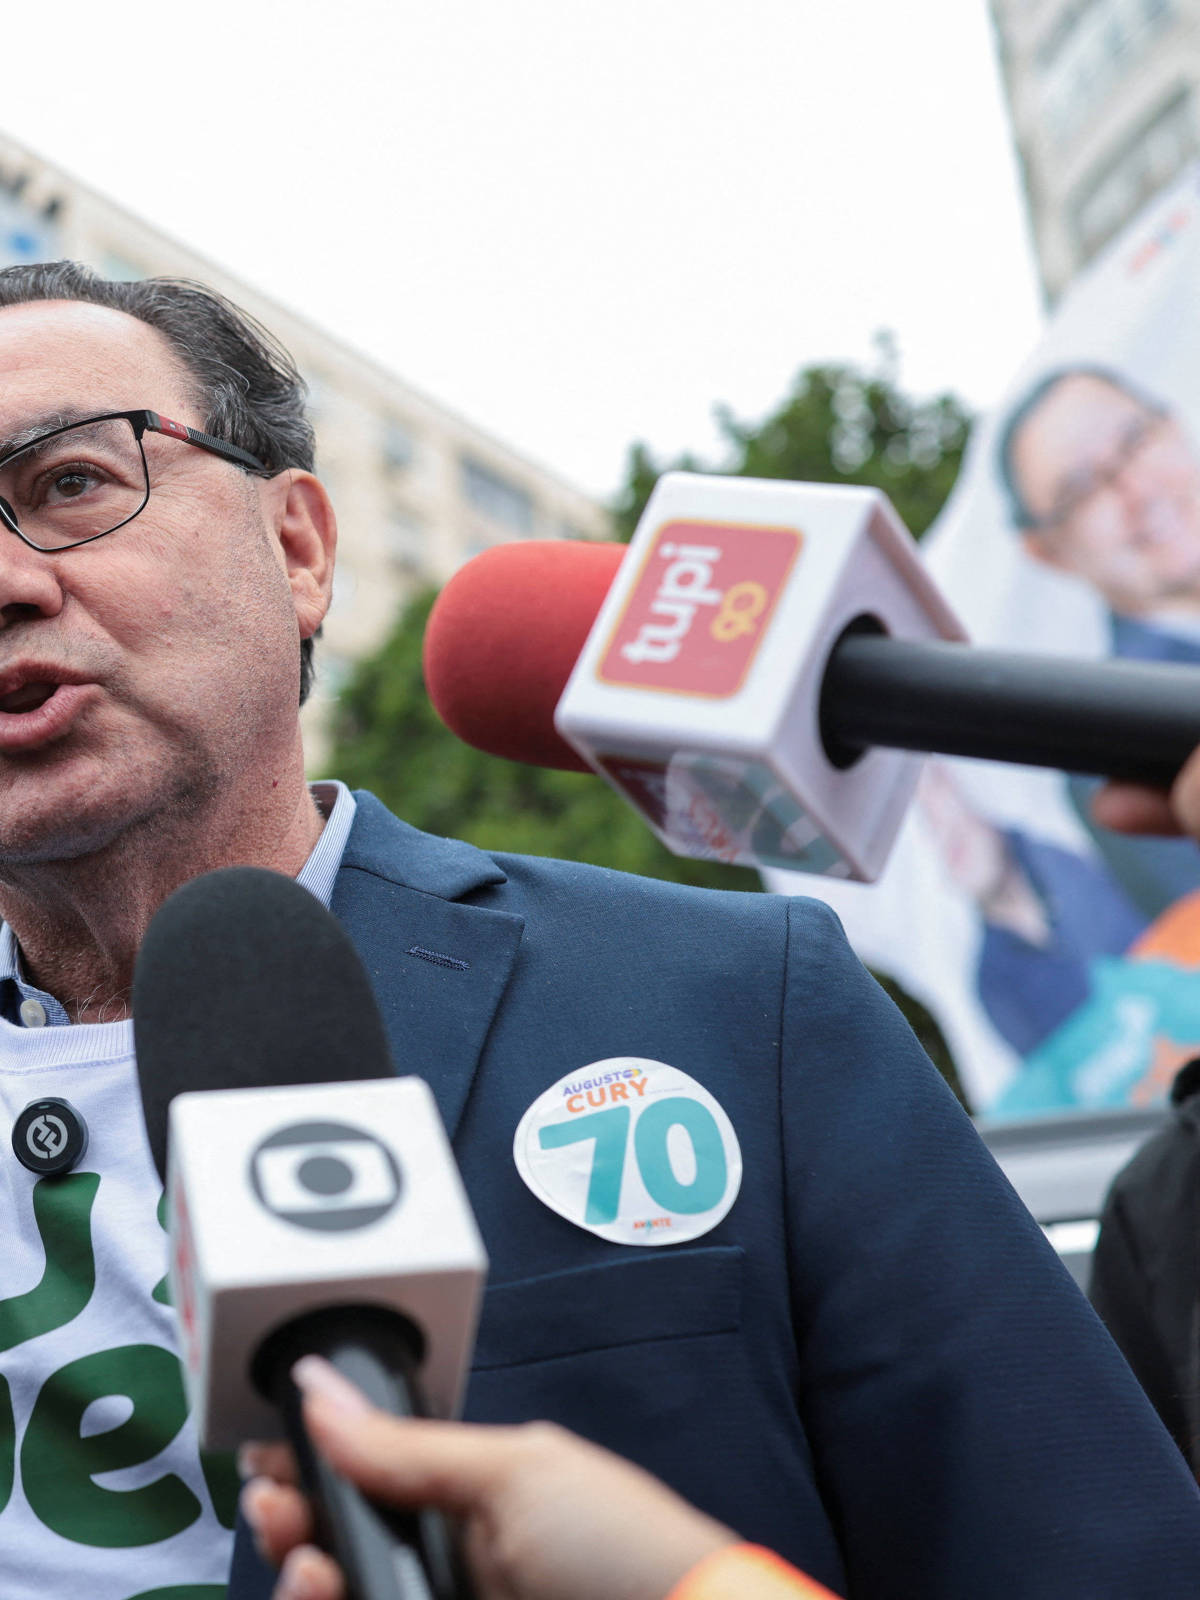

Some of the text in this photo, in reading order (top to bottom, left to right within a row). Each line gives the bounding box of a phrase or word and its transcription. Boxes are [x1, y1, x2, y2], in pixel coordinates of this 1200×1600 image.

[620, 542, 722, 664] tupi
[563, 1068, 641, 1097] AUGUSTO
[566, 1077, 649, 1113] CURY
[538, 1096, 728, 1225] 70
